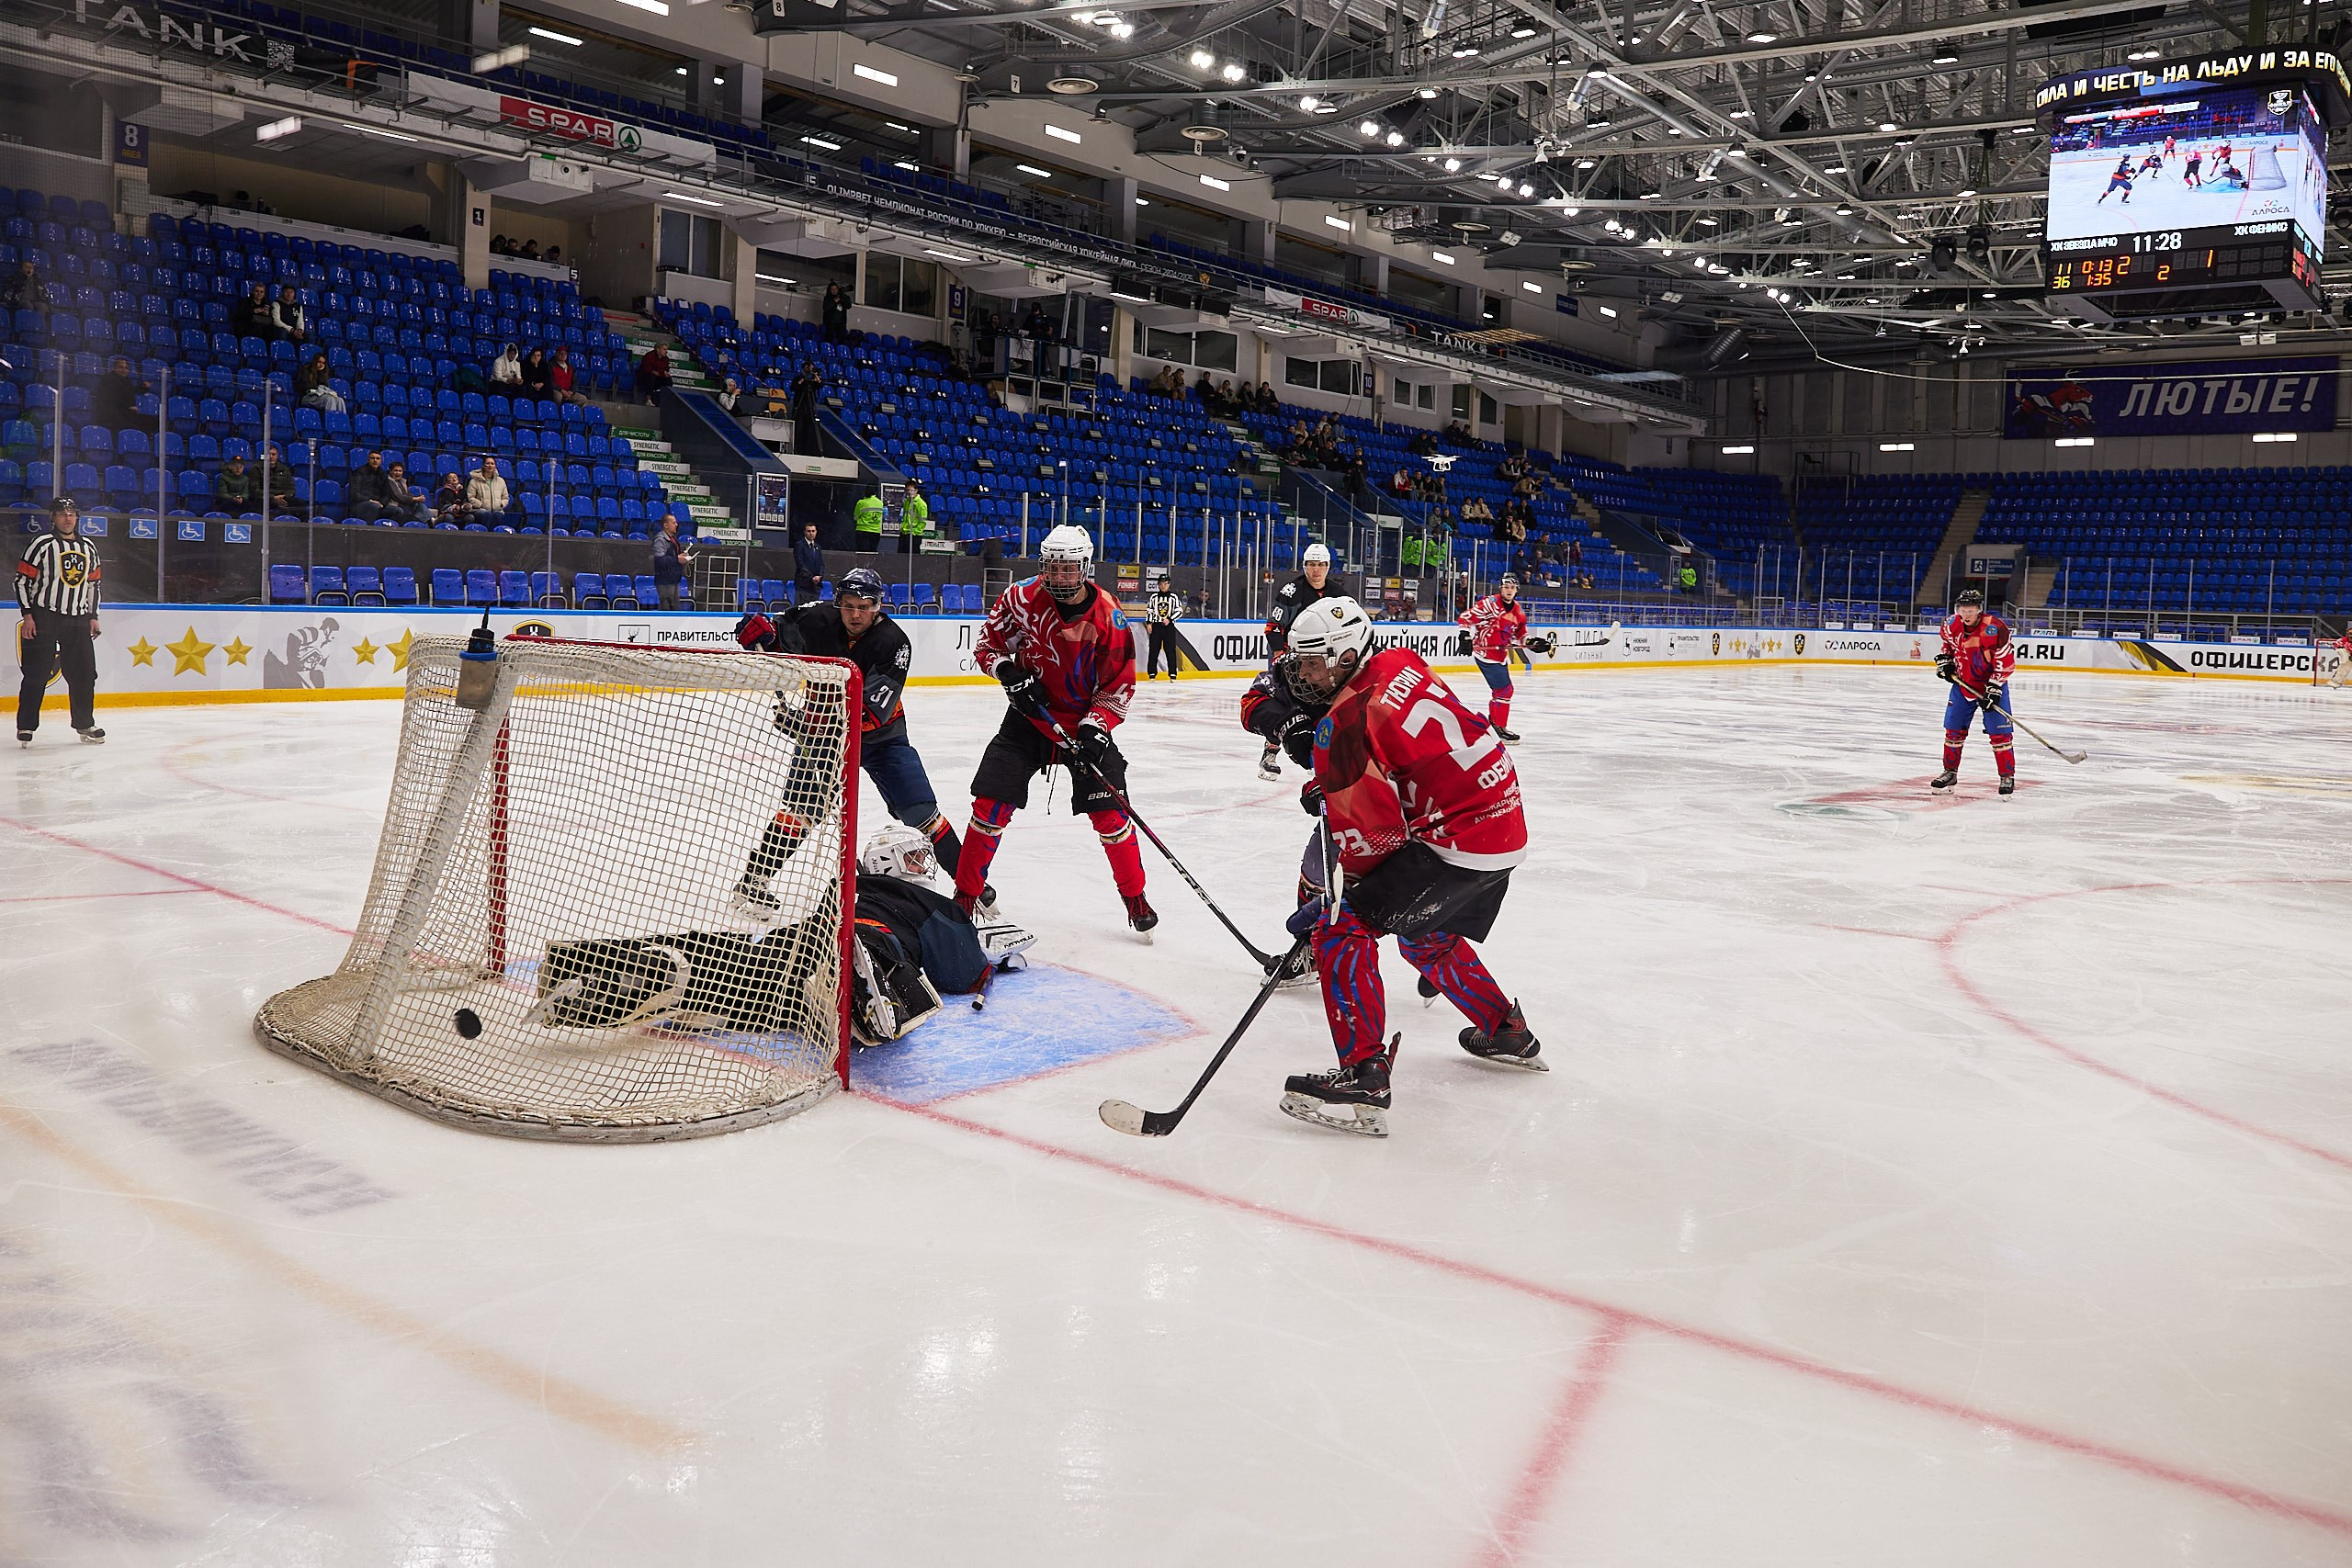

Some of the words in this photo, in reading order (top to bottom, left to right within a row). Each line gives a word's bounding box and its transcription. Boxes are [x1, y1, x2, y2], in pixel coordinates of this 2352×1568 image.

[75, 0, 251, 62] TANK
[2074, 78, 2087, 96] И
[2094, 70, 2156, 92] ЧЕСТЬ
[2163, 64, 2189, 84] НА
[2197, 54, 2253, 79] ЛЬДУ
[2259, 51, 2276, 70] И
[2283, 51, 2310, 68] ЗА
[1013, 79, 1018, 89] 7
[527, 107, 613, 141] SPAR
[124, 124, 139, 147] 8
[874, 197, 925, 217] ЧЕМПИОНАТ
[928, 210, 959, 225] РОССИИ
[962, 219, 973, 229] ПО
[2132, 232, 2182, 253] 11:28
[2117, 255, 2131, 275] 2
[2207, 249, 2213, 268] 1
[570, 269, 578, 280] 5
[2057, 263, 2072, 275] 11
[2081, 259, 2113, 274] 0:13
[2157, 265, 2170, 281] 2
[2052, 276, 2071, 289] 36
[2086, 273, 2111, 286] 1:35
[954, 291, 961, 307] 9
[1312, 303, 1348, 321] SPAR
[1430, 330, 1477, 355] TANK
[1364, 376, 1373, 389] 10
[2119, 377, 2320, 417] ЛЮТЫЕ!
[633, 442, 660, 450] SYNERGETIC
[651, 463, 678, 472] SYNERGETIC
[671, 484, 697, 492] SYNERGETIC
[692, 506, 718, 514] SYNERGETIC
[712, 529, 739, 537] SYNERGETIC
[1575, 651, 1603, 660] СИЛЬНЫХ
[1087, 789, 1125, 801] BAUR
